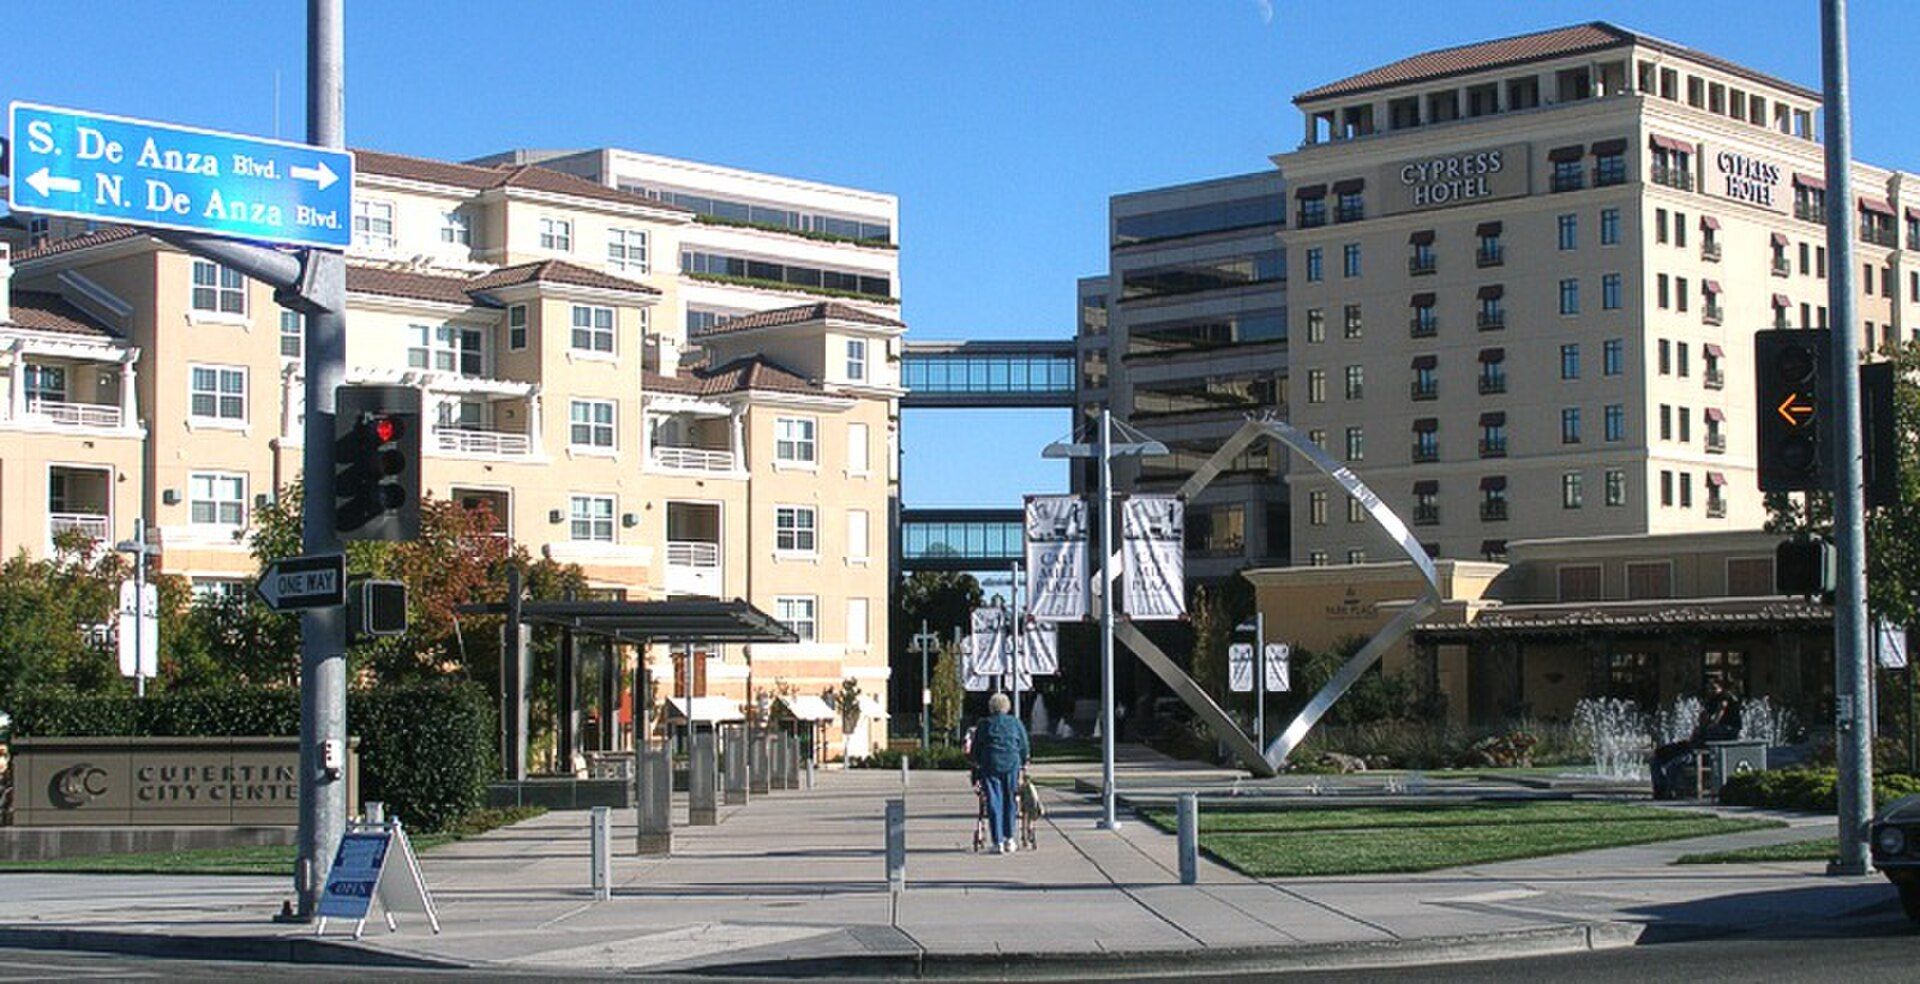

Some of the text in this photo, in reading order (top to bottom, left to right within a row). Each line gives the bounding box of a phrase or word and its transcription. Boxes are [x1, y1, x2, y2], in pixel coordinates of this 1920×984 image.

[27, 120, 281, 180] S. De Anza Blvd.
[1401, 151, 1502, 185] CYPRESS
[1717, 151, 1780, 185] CYPRESS
[95, 173, 342, 230] N. De Anza Blvd.
[1414, 176, 1491, 205] HOTEL
[1726, 175, 1774, 206] HOTEL
[278, 571, 335, 596] ONE WAY
[137, 765, 295, 782] CUPERTIN
[137, 784, 298, 800] CITY CENTE
